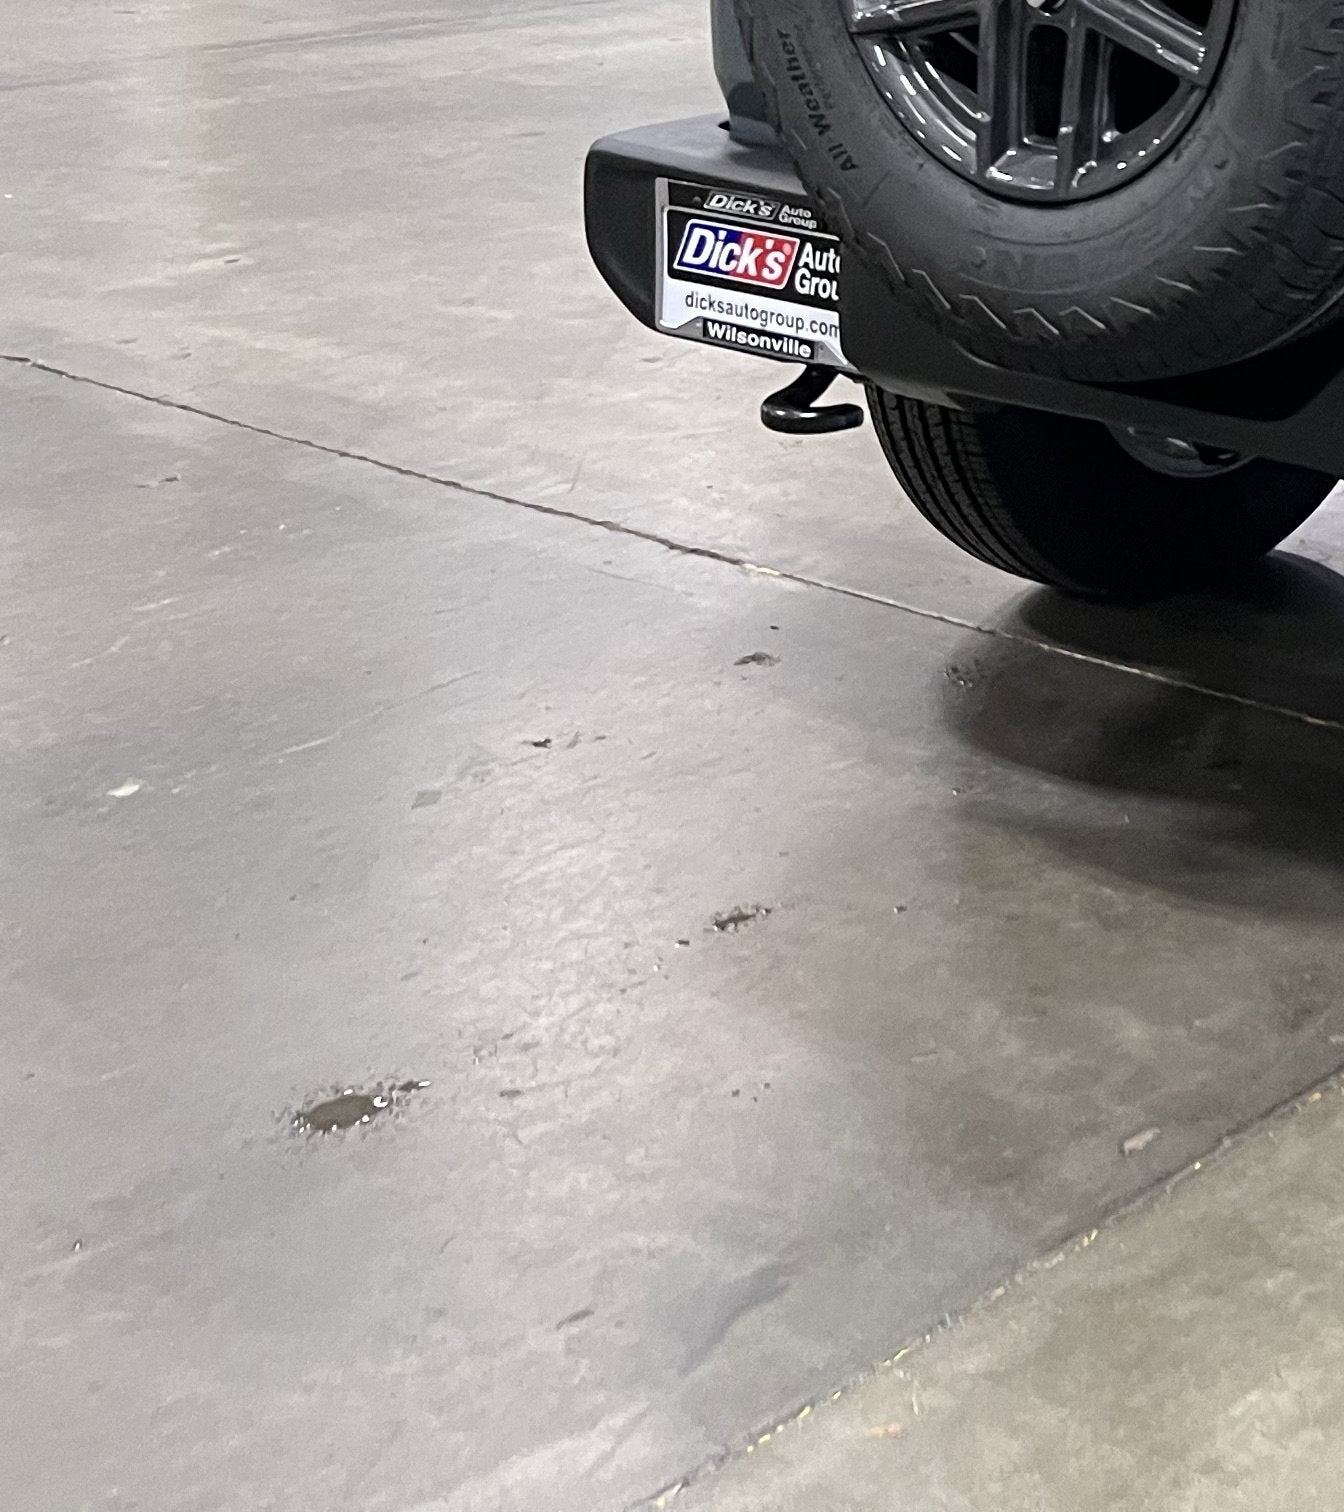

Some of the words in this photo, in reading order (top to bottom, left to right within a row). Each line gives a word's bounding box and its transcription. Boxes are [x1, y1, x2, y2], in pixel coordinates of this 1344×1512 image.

[776, 28, 832, 136] Weather
[828, 143, 860, 171] All
[709, 194, 773, 217] Dick's
[782, 204, 812, 219] Auto
[778, 214, 818, 230] Group
[682, 227, 787, 281] Dick's
[707, 321, 812, 358] Wilsonville
